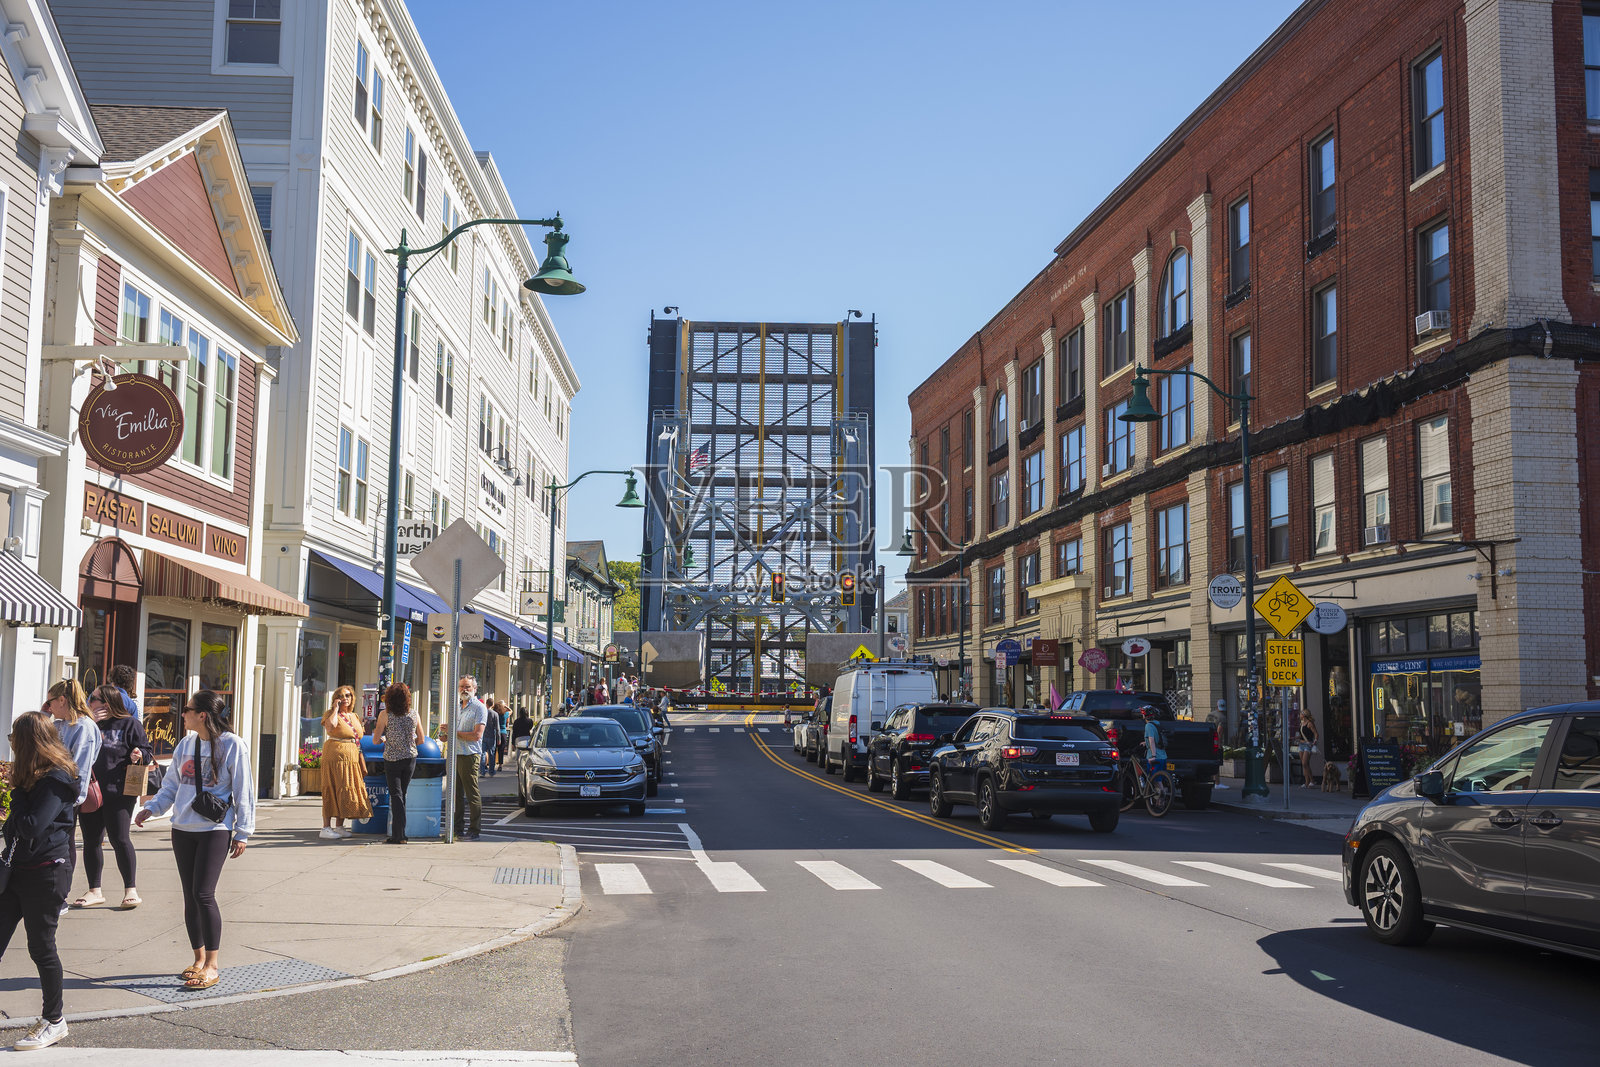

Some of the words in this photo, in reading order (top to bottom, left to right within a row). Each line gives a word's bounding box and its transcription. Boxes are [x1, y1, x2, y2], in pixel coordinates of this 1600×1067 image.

[96, 403, 118, 419] Via
[116, 408, 168, 440] Emilia
[102, 442, 157, 459] RISTORANTE
[85, 491, 138, 527] PASTA
[150, 514, 198, 546] SALUMI
[212, 534, 238, 556] VINO
[398, 523, 431, 538] orth
[1269, 646, 1300, 654] STEEL
[1274, 659, 1297, 667] GRID
[1377, 663, 1399, 671] SPENCER
[1404, 661, 1422, 670] LYNN
[1272, 672, 1298, 680] DECK
[156, 719, 176, 747] Emilia
[366, 786, 389, 795] CYCLING
